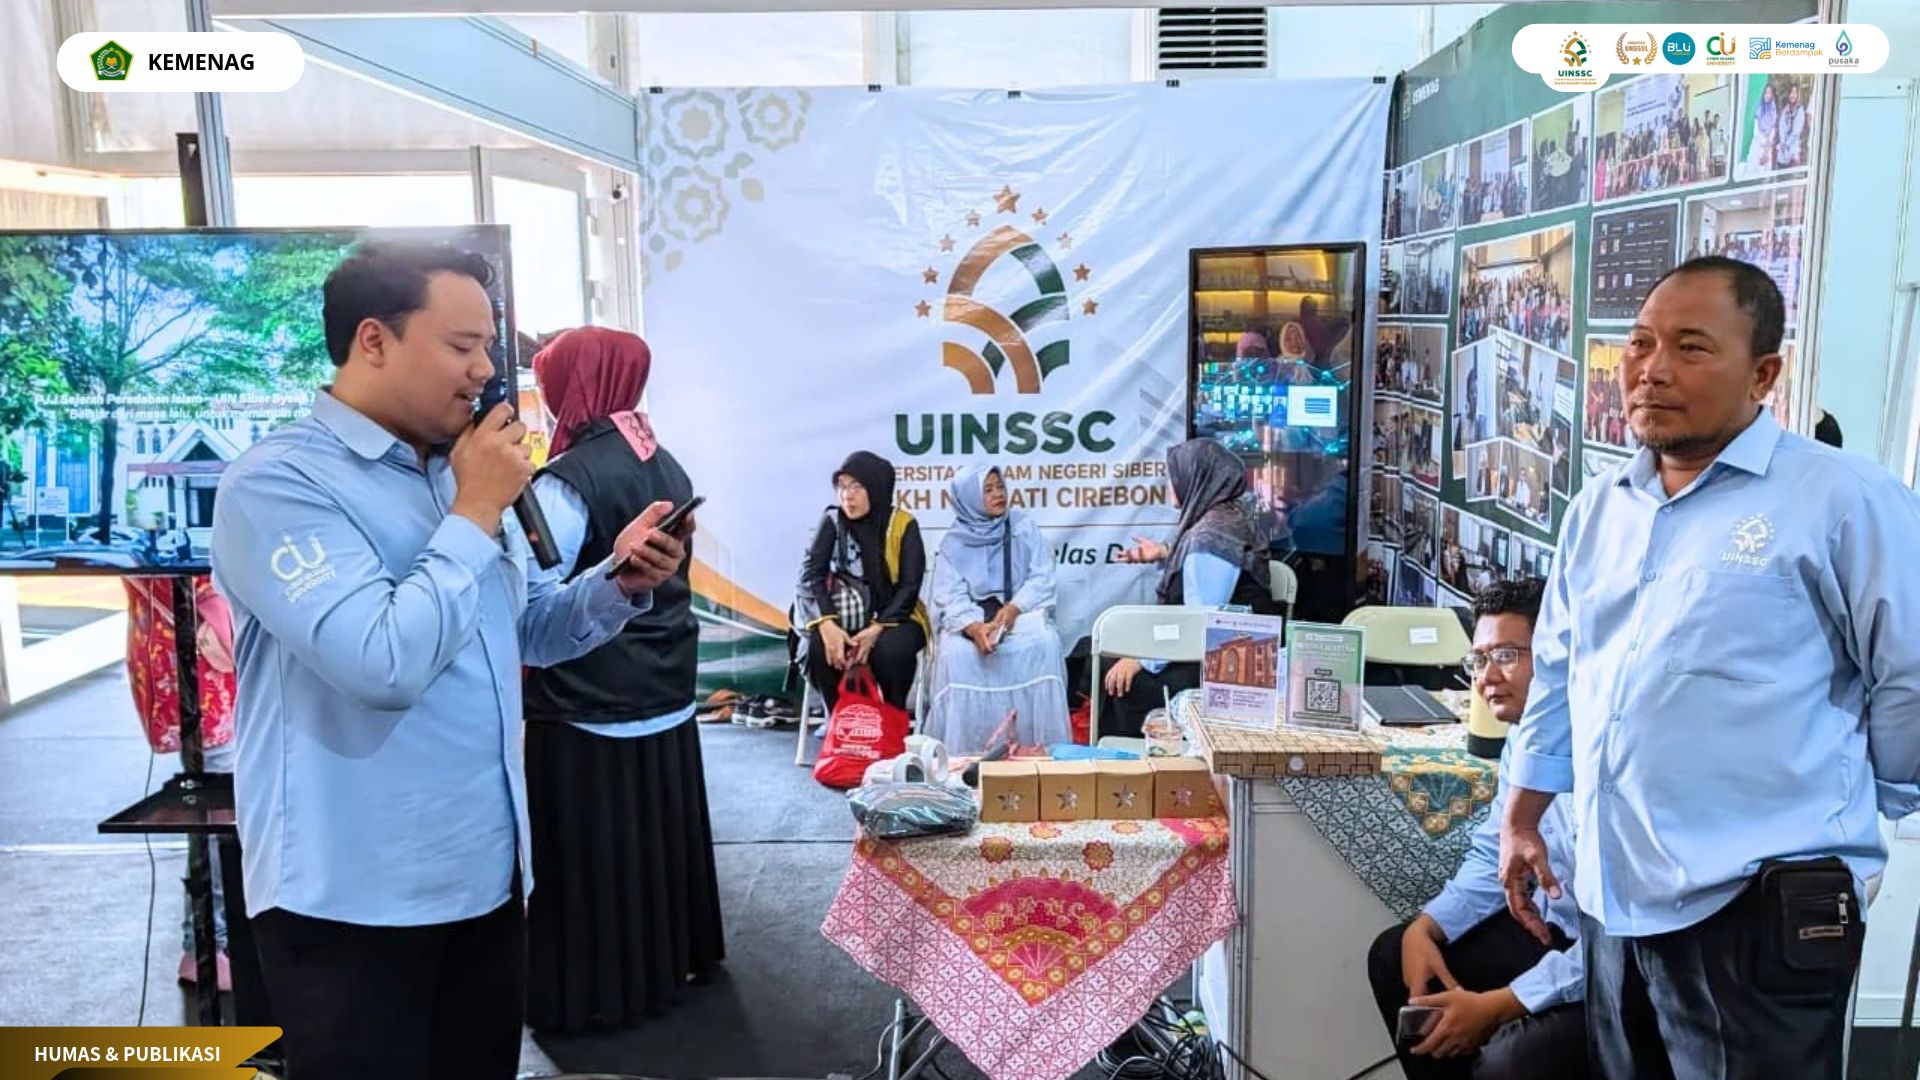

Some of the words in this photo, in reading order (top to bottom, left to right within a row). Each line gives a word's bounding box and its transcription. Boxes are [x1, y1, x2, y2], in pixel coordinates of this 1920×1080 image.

[895, 410, 1116, 456] UINSSC
[1038, 463, 1106, 480] NEGERI
[1113, 461, 1166, 479] SIBER
[1056, 484, 1166, 508] CIREBON
